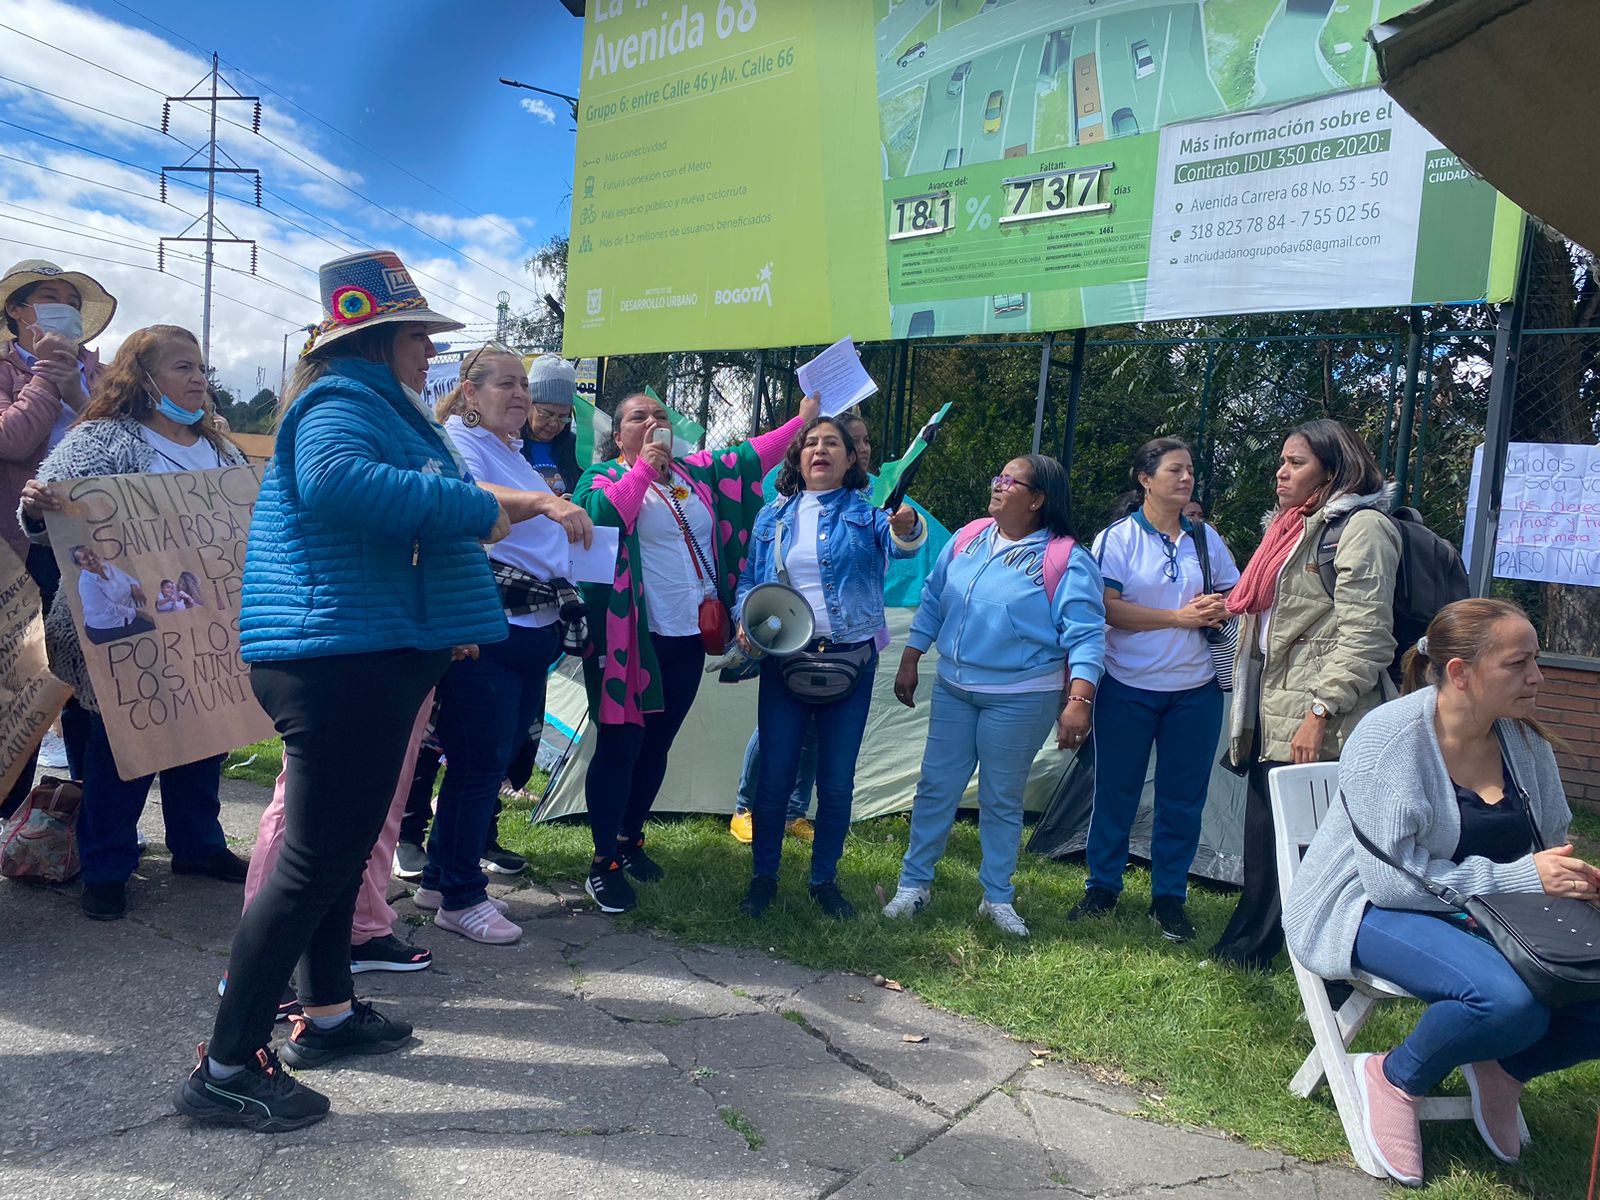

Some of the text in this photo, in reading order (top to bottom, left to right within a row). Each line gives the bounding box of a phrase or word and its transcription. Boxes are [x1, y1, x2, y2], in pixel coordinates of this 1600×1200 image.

[589, 0, 757, 80] Avenida 68
[586, 47, 794, 121] Grupo 6: entre Calle 46 y Av. Calle 66
[1180, 102, 1392, 156] Más información sobre el
[619, 141, 667, 159] conectividad
[1177, 134, 1384, 184] Contrato IDU 350 de 2020:
[602, 178, 625, 191] Futura
[662, 168, 677, 178] con
[678, 164, 686, 175] el
[687, 160, 712, 173] Metro
[928, 176, 968, 191] Avance del:
[1040, 161, 1066, 173] Faltan:
[616, 205, 643, 218] espacio
[645, 197, 673, 214] público
[680, 193, 705, 205] nueva
[706, 185, 747, 200] ciclorruta
[1012, 171, 1132, 214] 737 días
[1190, 192, 1238, 213] Avenida
[1241, 187, 1287, 206] Carrera
[1290, 183, 1308, 199] 68
[1312, 179, 1334, 196] No.
[1339, 175, 1356, 192] 53
[1370, 170, 1389, 188] 50
[614, 234, 625, 246] de
[636, 229, 669, 242] millones
[670, 226, 680, 237] de
[681, 221, 715, 236] usuarios
[716, 213, 772, 231] beneficiados
[966, 195, 992, 231] %
[1190, 224, 1213, 241] 318
[1216, 218, 1242, 237] 823
[1246, 216, 1264, 234] 78
[1267, 214, 1286, 231] 84
[1301, 210, 1310, 227] 7
[1312, 207, 1333, 226] 55
[1336, 204, 1356, 223] 02
[1360, 201, 1380, 220] 56
[1099, 226, 1114, 235] 1461
[1183, 232, 1381, 264] atnciudadanogrupo6av68@gmail.com
[620, 293, 698, 312] DESARROLLO URBANO
[93, 510, 248, 561] SANTA ROSA
[1533, 533, 1590, 549] primera
[1566, 517, 1575, 533] y
[1496, 551, 1544, 575] PARO
[108, 632, 183, 677] POR
[116, 664, 185, 706] LOS
